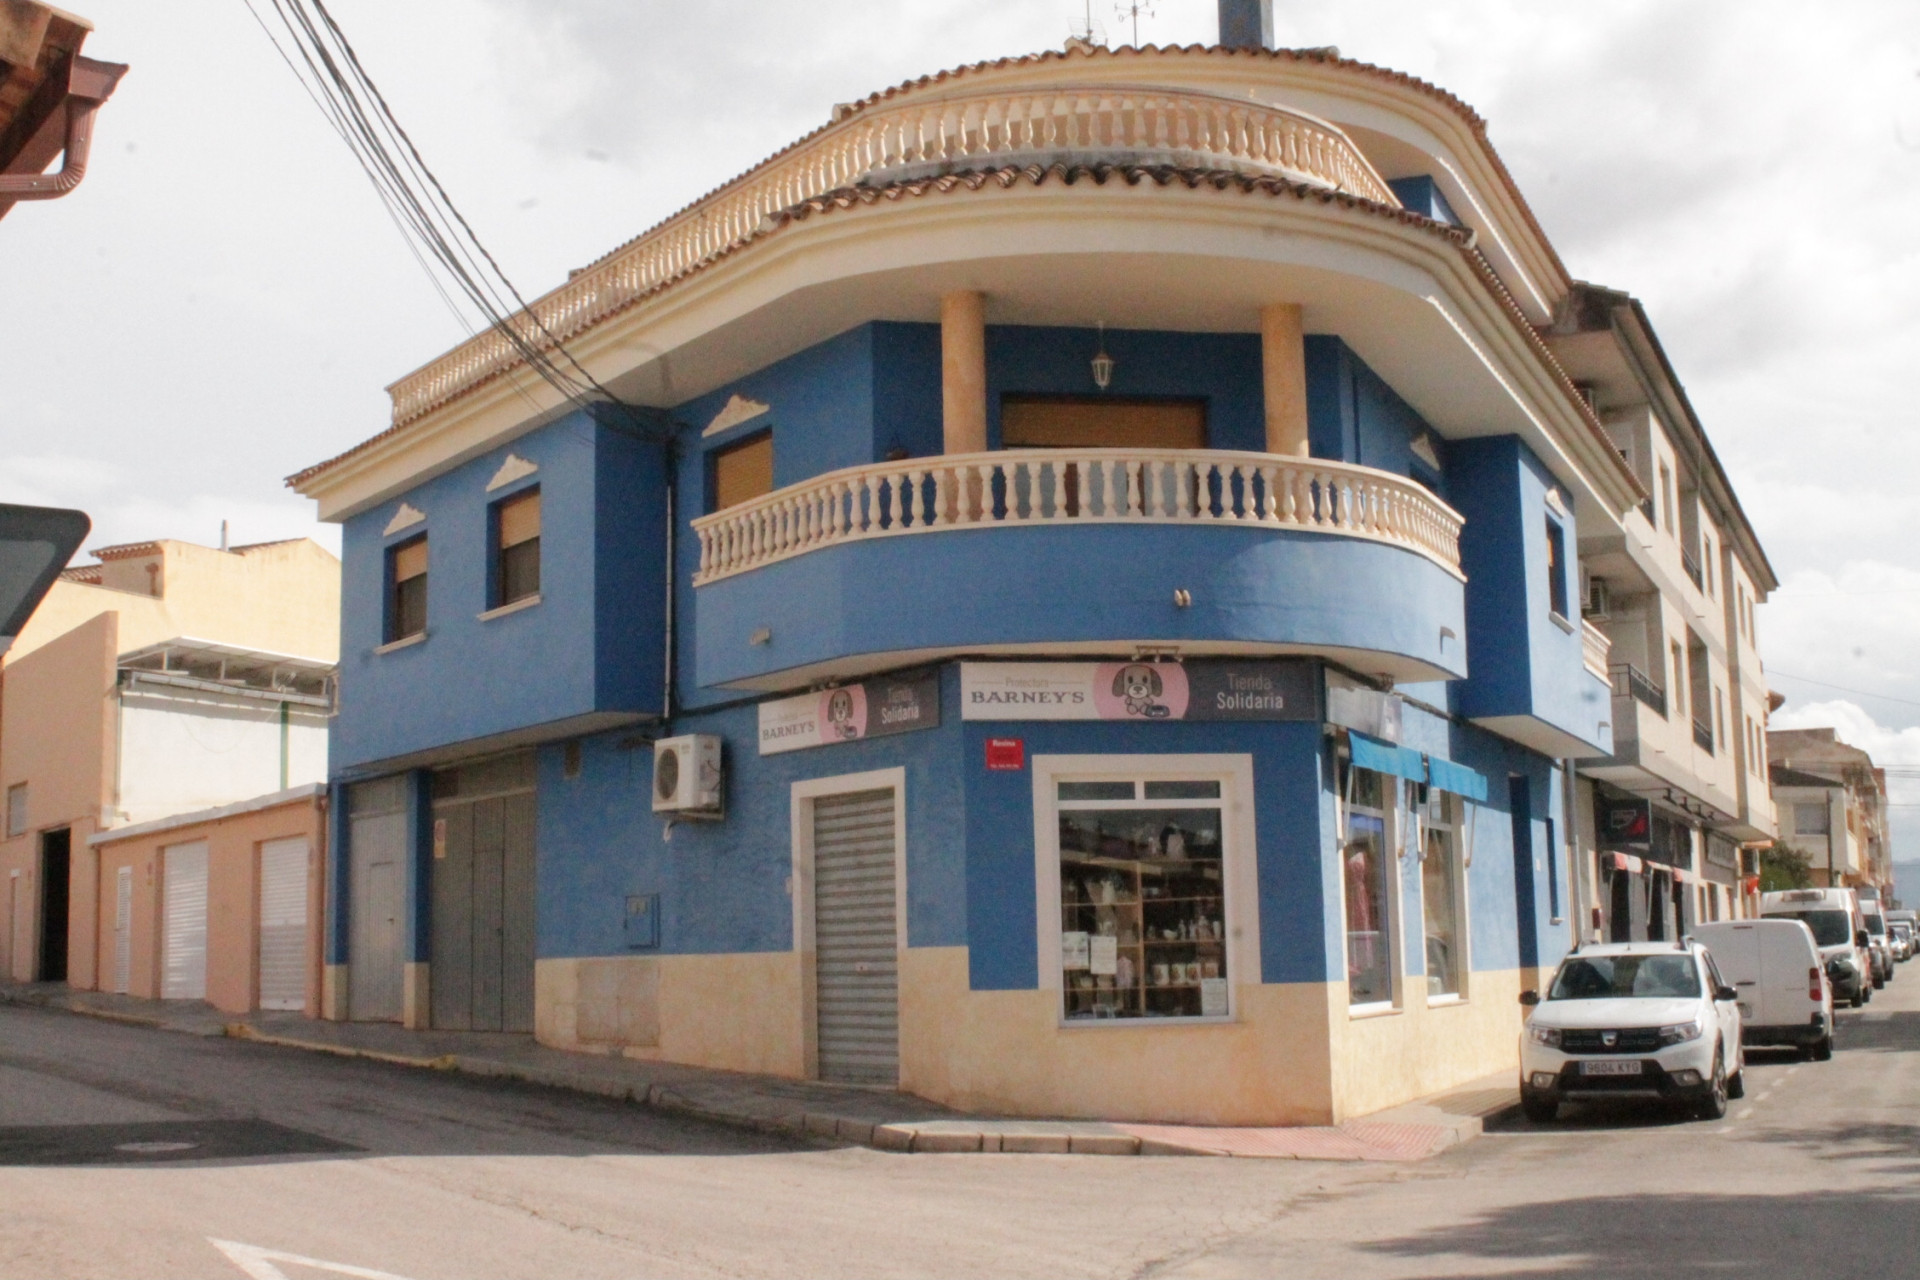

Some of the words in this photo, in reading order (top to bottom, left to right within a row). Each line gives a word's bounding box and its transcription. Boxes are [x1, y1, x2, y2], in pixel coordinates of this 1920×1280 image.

[1227, 673, 1273, 690] Tienda
[971, 691, 1085, 704] BARNEY'S
[1216, 691, 1284, 710] Solidaria
[881, 703, 920, 724] Solidaria
[763, 721, 815, 741] BARNEY'S
